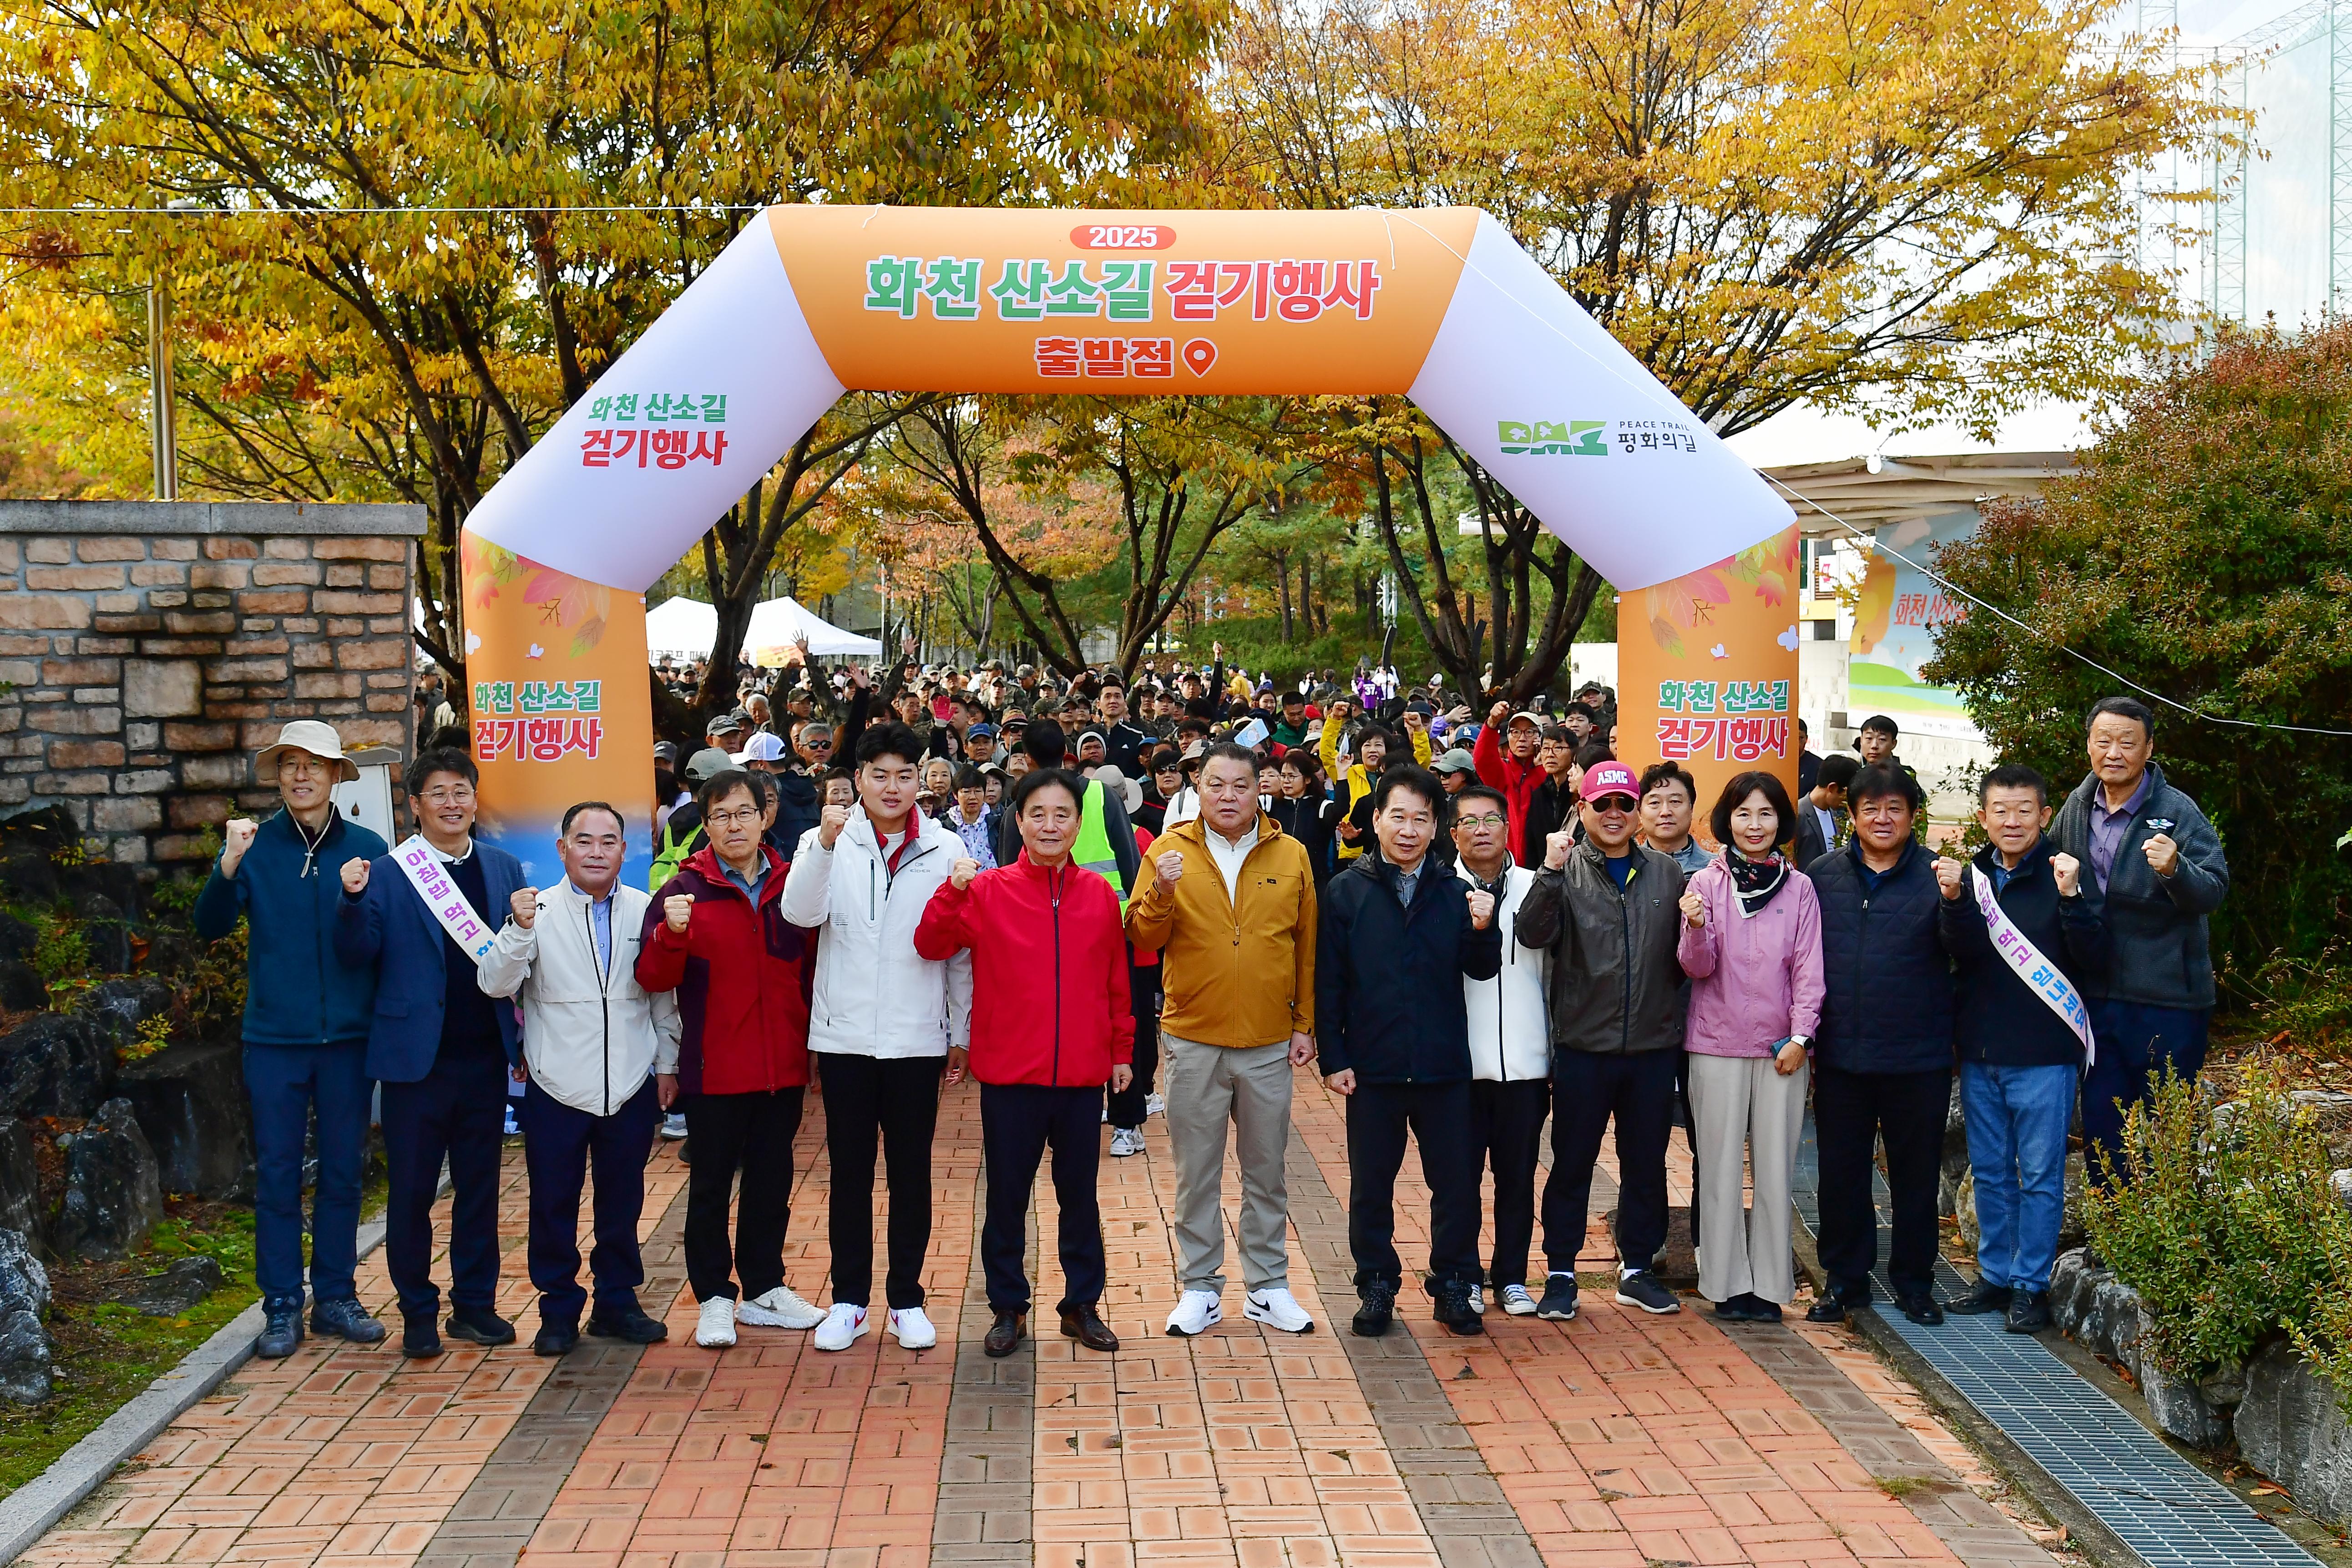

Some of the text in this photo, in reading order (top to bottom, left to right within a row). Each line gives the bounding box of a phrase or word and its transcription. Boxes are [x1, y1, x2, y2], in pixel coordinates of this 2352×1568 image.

[1089, 227, 1158, 248] 2025
[865, 255, 1381, 322] 화천 산소길 걷기행사
[1034, 335, 1175, 378] 출발점
[588, 393, 727, 422] 화천 산소길
[1618, 432, 1697, 453] 평화의길
[1619, 420, 1690, 431] PEACE TRAIL
[580, 429, 728, 470] 걷기행사
[1894, 594, 1927, 626] 화천
[475, 680, 602, 714] 화천 산소길
[1659, 680, 1789, 713] 화천 산소길
[476, 717, 603, 762] 걷기행사
[1656, 716, 1789, 762] 걷기행사
[1597, 770, 1629, 786] ASMC
[406, 849, 481, 941] 아침밥 먹고
[1978, 877, 2000, 928] 아침밥
[1998, 928, 2033, 967] 먹고
